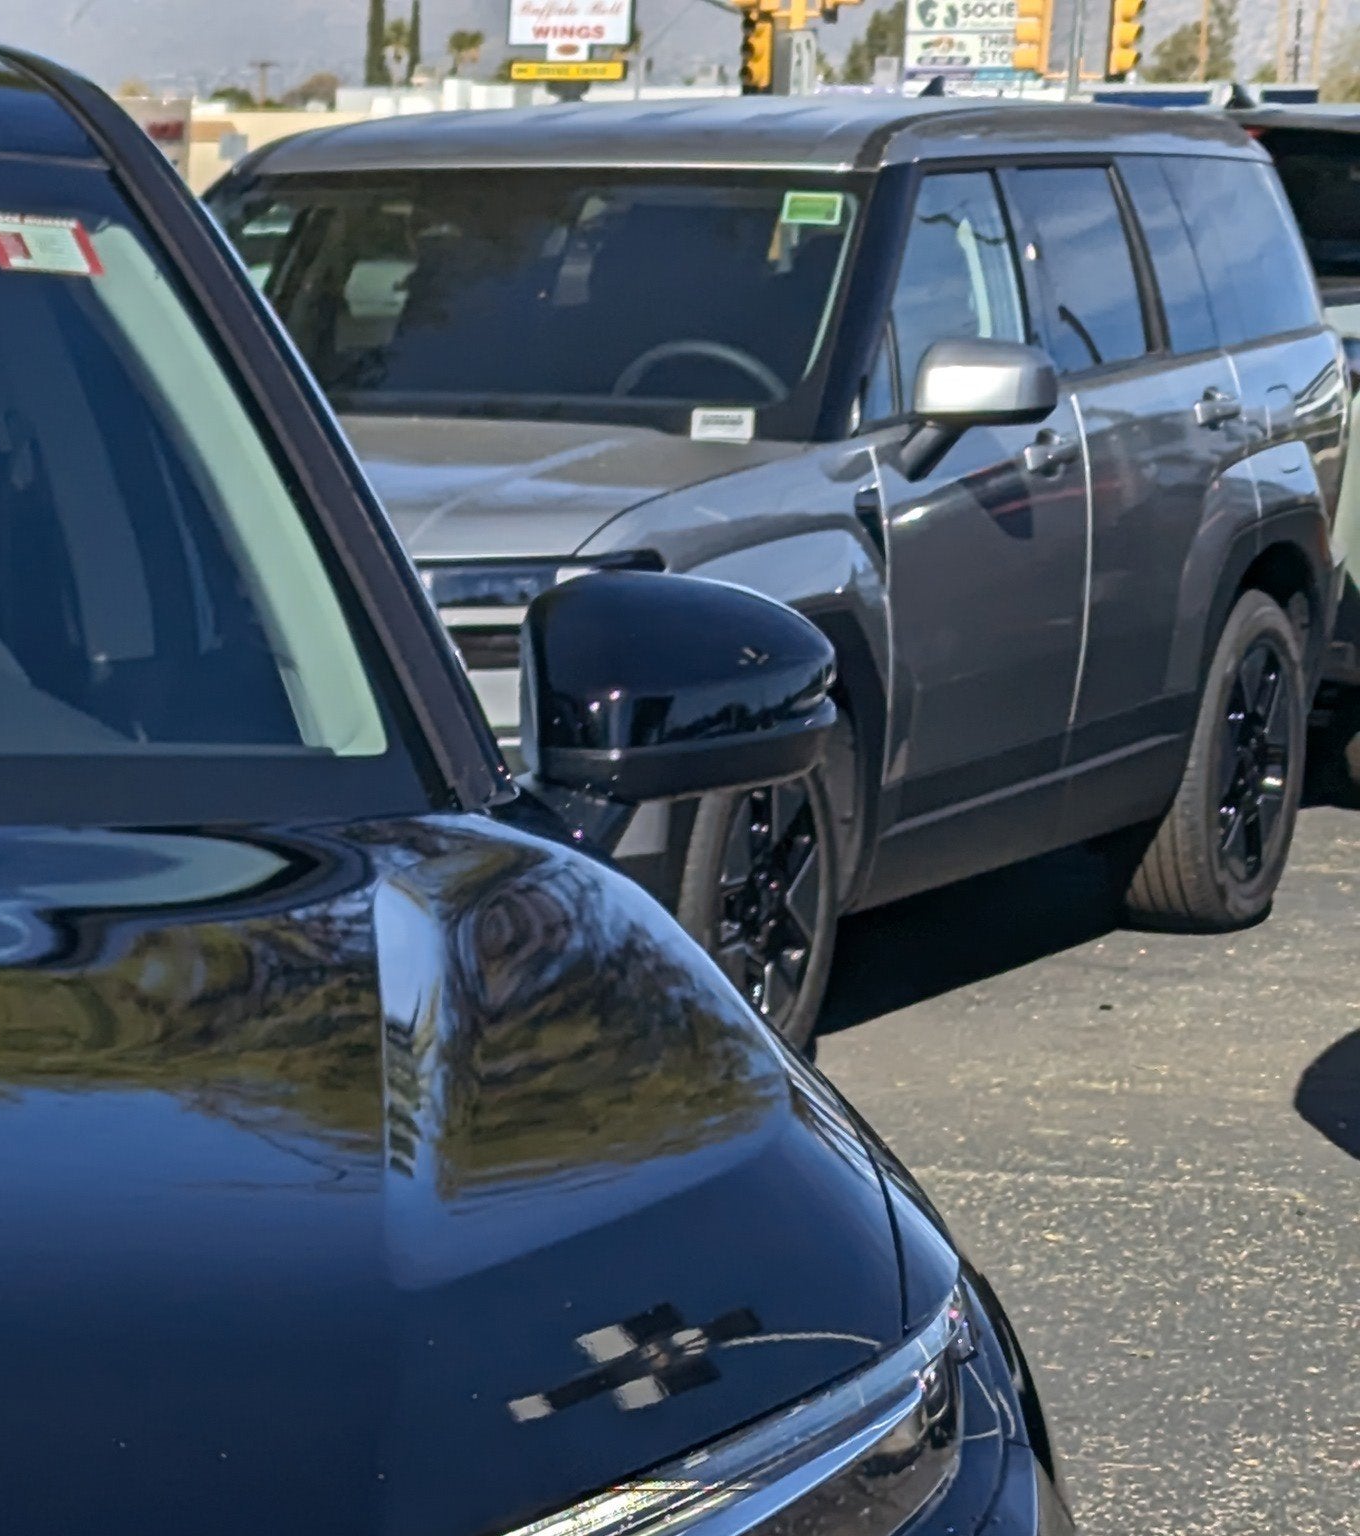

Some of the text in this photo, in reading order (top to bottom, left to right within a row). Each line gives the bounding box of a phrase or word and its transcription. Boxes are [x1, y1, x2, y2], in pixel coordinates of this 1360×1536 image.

[961, 2, 1016, 18] SOCIE
[532, 25, 605, 39] WINGS
[979, 50, 1012, 64] STO
